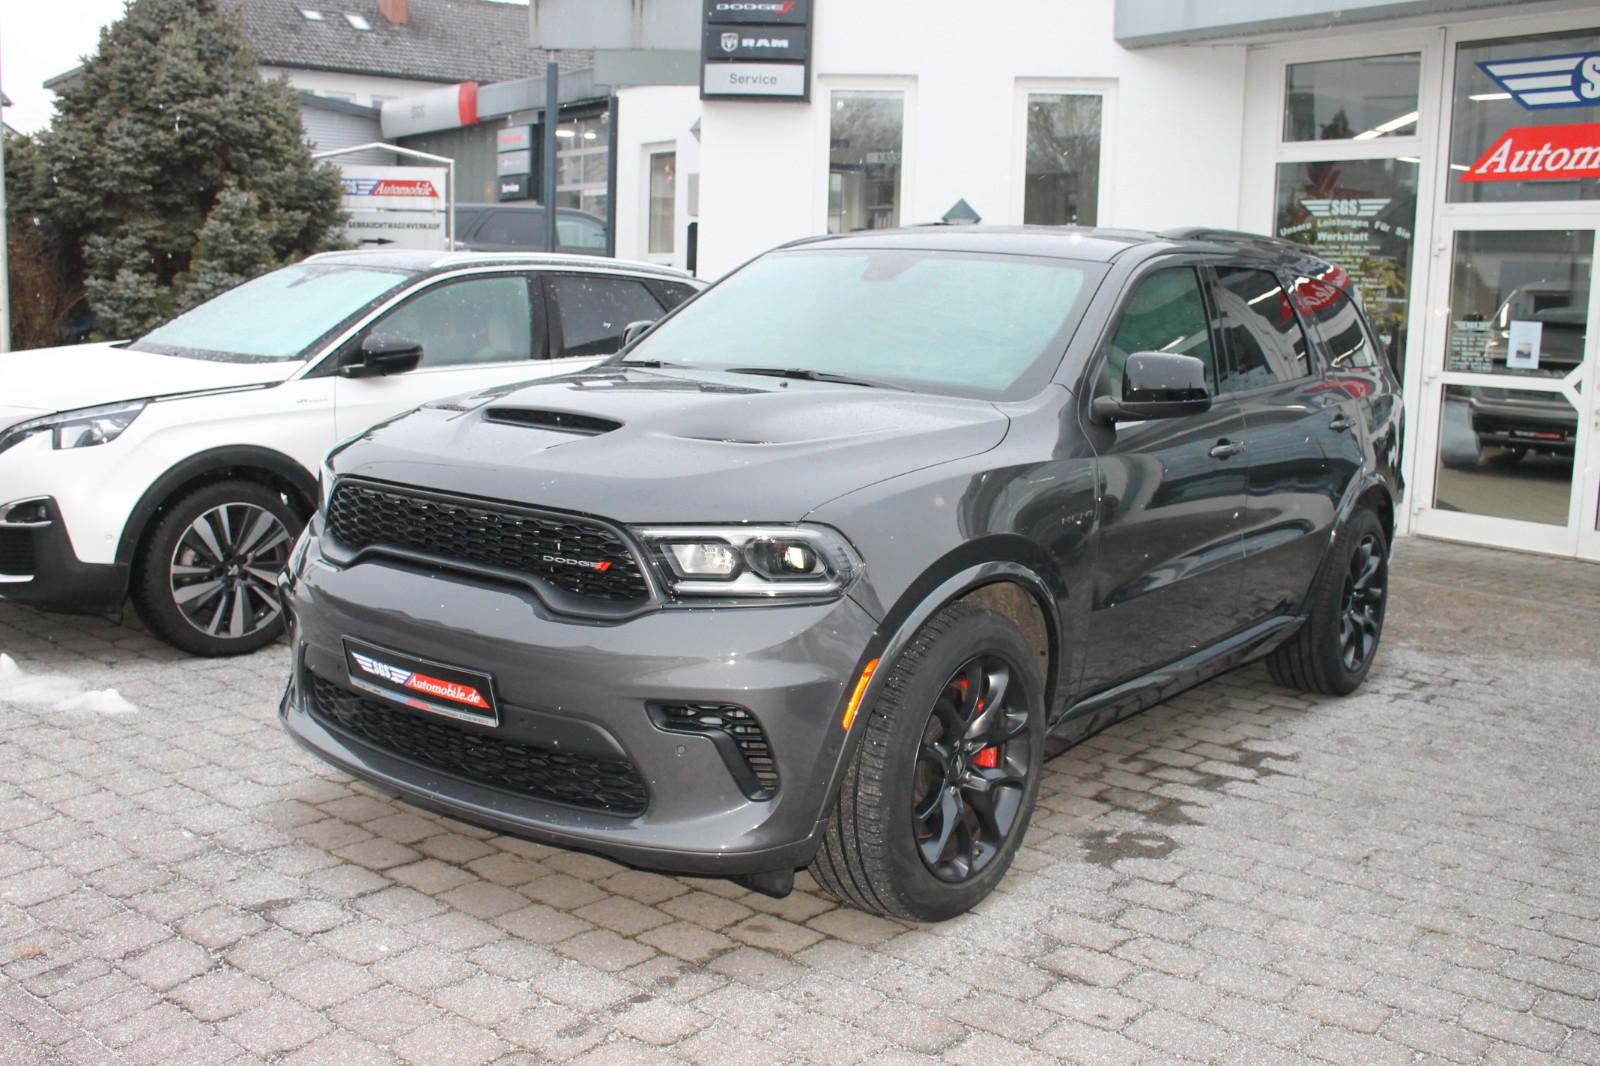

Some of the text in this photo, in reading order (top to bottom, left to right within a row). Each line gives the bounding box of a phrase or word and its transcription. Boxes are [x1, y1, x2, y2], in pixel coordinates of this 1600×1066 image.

[716, 3, 785, 11] DODGE
[742, 38, 789, 48] RAM
[729, 73, 777, 85] Service
[1331, 199, 1358, 216] SGS
[348, 221, 440, 230] GEBRAUCHTWAGENVERKAUF
[1280, 219, 1411, 239] Unsere Leistungen Für Sie
[1317, 231, 1368, 241] Werkstatt
[543, 555, 602, 568] DODGE
[372, 661, 391, 679] SGS
[408, 677, 480, 704] Automobile.de
